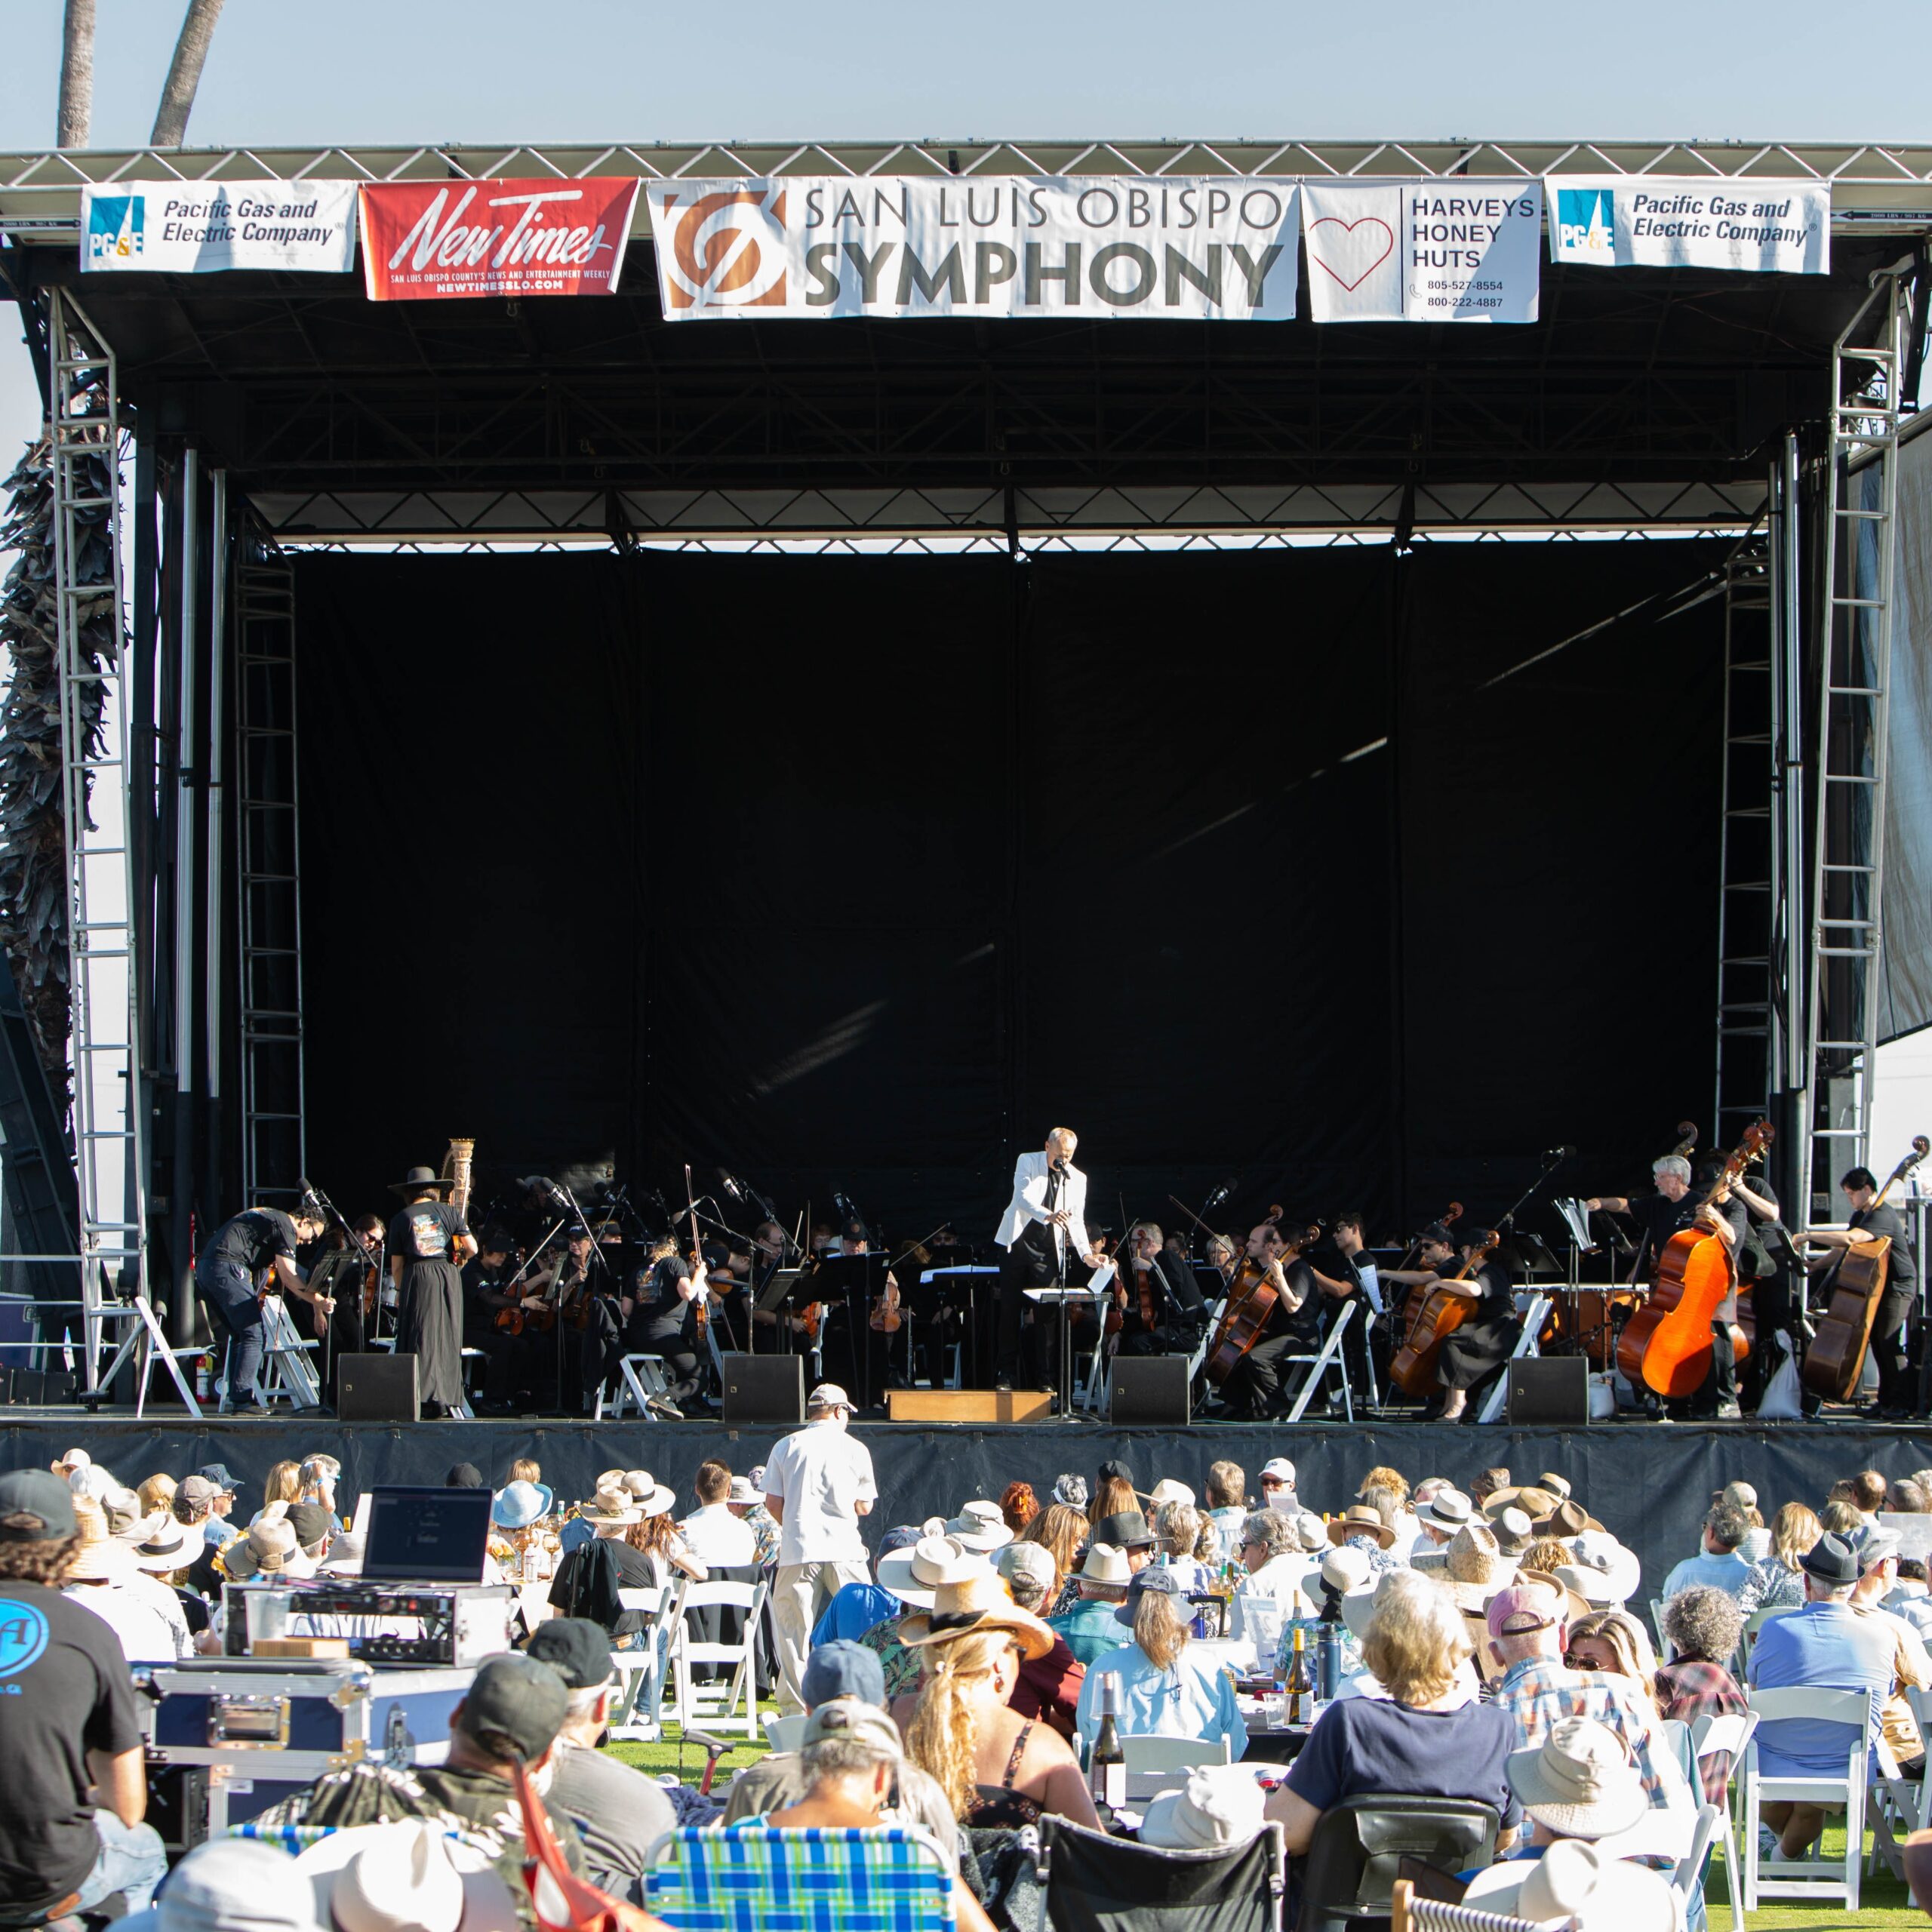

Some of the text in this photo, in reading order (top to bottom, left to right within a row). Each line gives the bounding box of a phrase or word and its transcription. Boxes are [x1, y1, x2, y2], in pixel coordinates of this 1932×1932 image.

[164, 198, 318, 219] Pacific Gas and
[805, 186, 1282, 230] SAN LUIS OBISPO
[1412, 198, 1534, 217] HARVEYS
[1633, 194, 1791, 218] Pacific Gas and
[162, 221, 236, 242] Electric
[388, 186, 614, 272] New Times
[1412, 223, 1502, 242] HONEY
[1560, 223, 1614, 250] PG&E
[1633, 217, 1710, 238] Electric
[88, 232, 144, 257] PG&E
[1413, 250, 1481, 268] HUTS
[390, 269, 611, 284] SAN LUIS OBISPO COUNTY'S NEWS AND ENTERTAINMENT WEEKLY
[805, 241, 1284, 307] SYMPHONY
[436, 280, 563, 294] NEWTIMESSLO.COM
[1428, 280, 1503, 291] 805-527-8554
[1428, 297, 1503, 307] 800-222-4887
